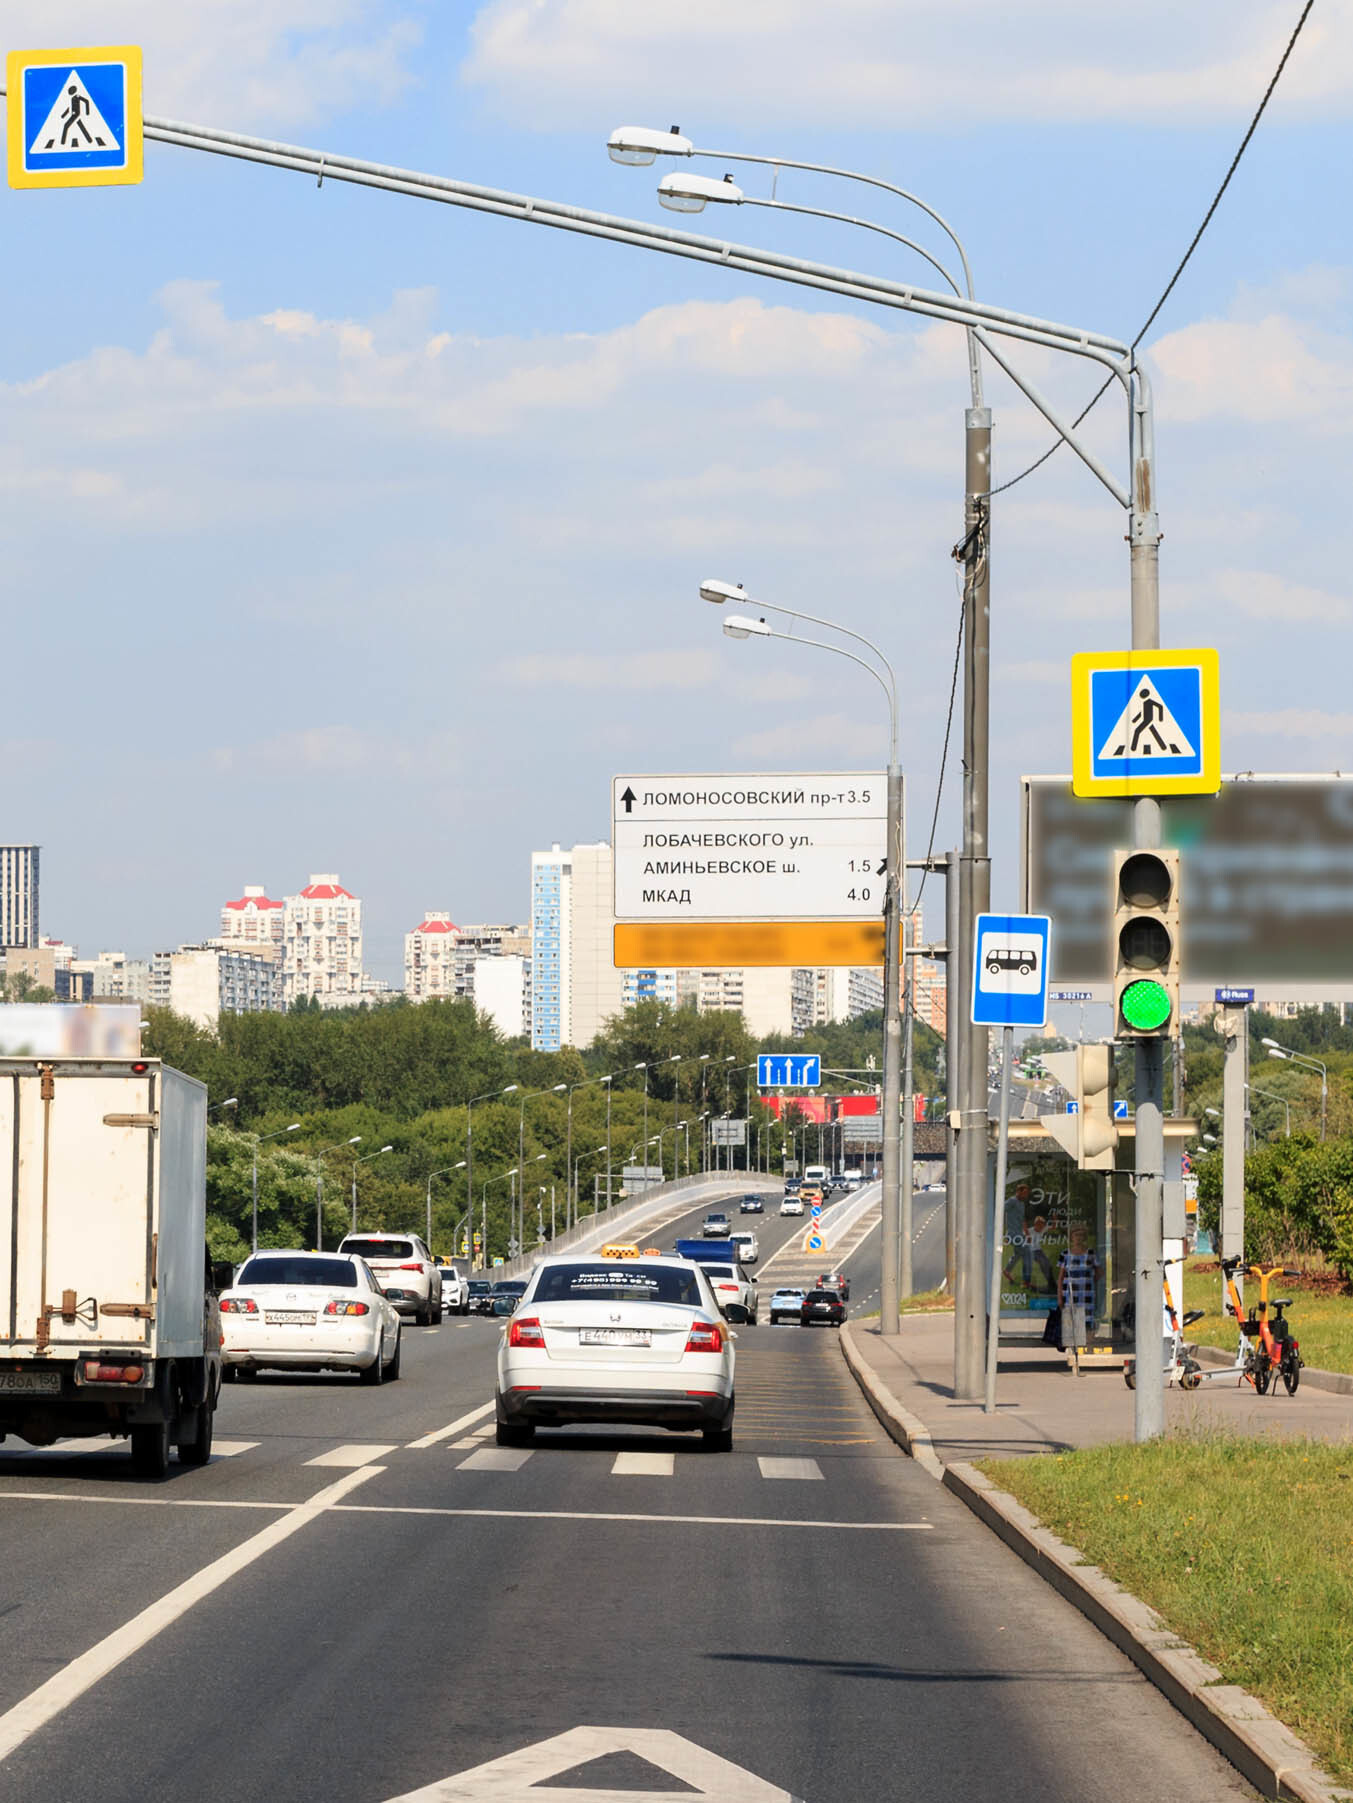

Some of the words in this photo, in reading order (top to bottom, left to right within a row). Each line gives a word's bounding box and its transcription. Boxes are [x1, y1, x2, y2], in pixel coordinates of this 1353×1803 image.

[643, 790, 805, 806] ЛОМОНОСОВСКИЙ
[810, 793, 844, 807] пр-т
[847, 790, 871, 803] 3.5
[643, 833, 784, 848] ЛОБАЧЕВСКОГО
[789, 836, 813, 850] ул.
[643, 860, 776, 875] АМИНЬЕВСКОЕ
[782, 863, 800, 873] ш.
[848, 859, 871, 872] 1.5
[642, 889, 692, 905] МКАД
[847, 888, 871, 901] 4.0
[1030, 1188, 1070, 1206] Эти
